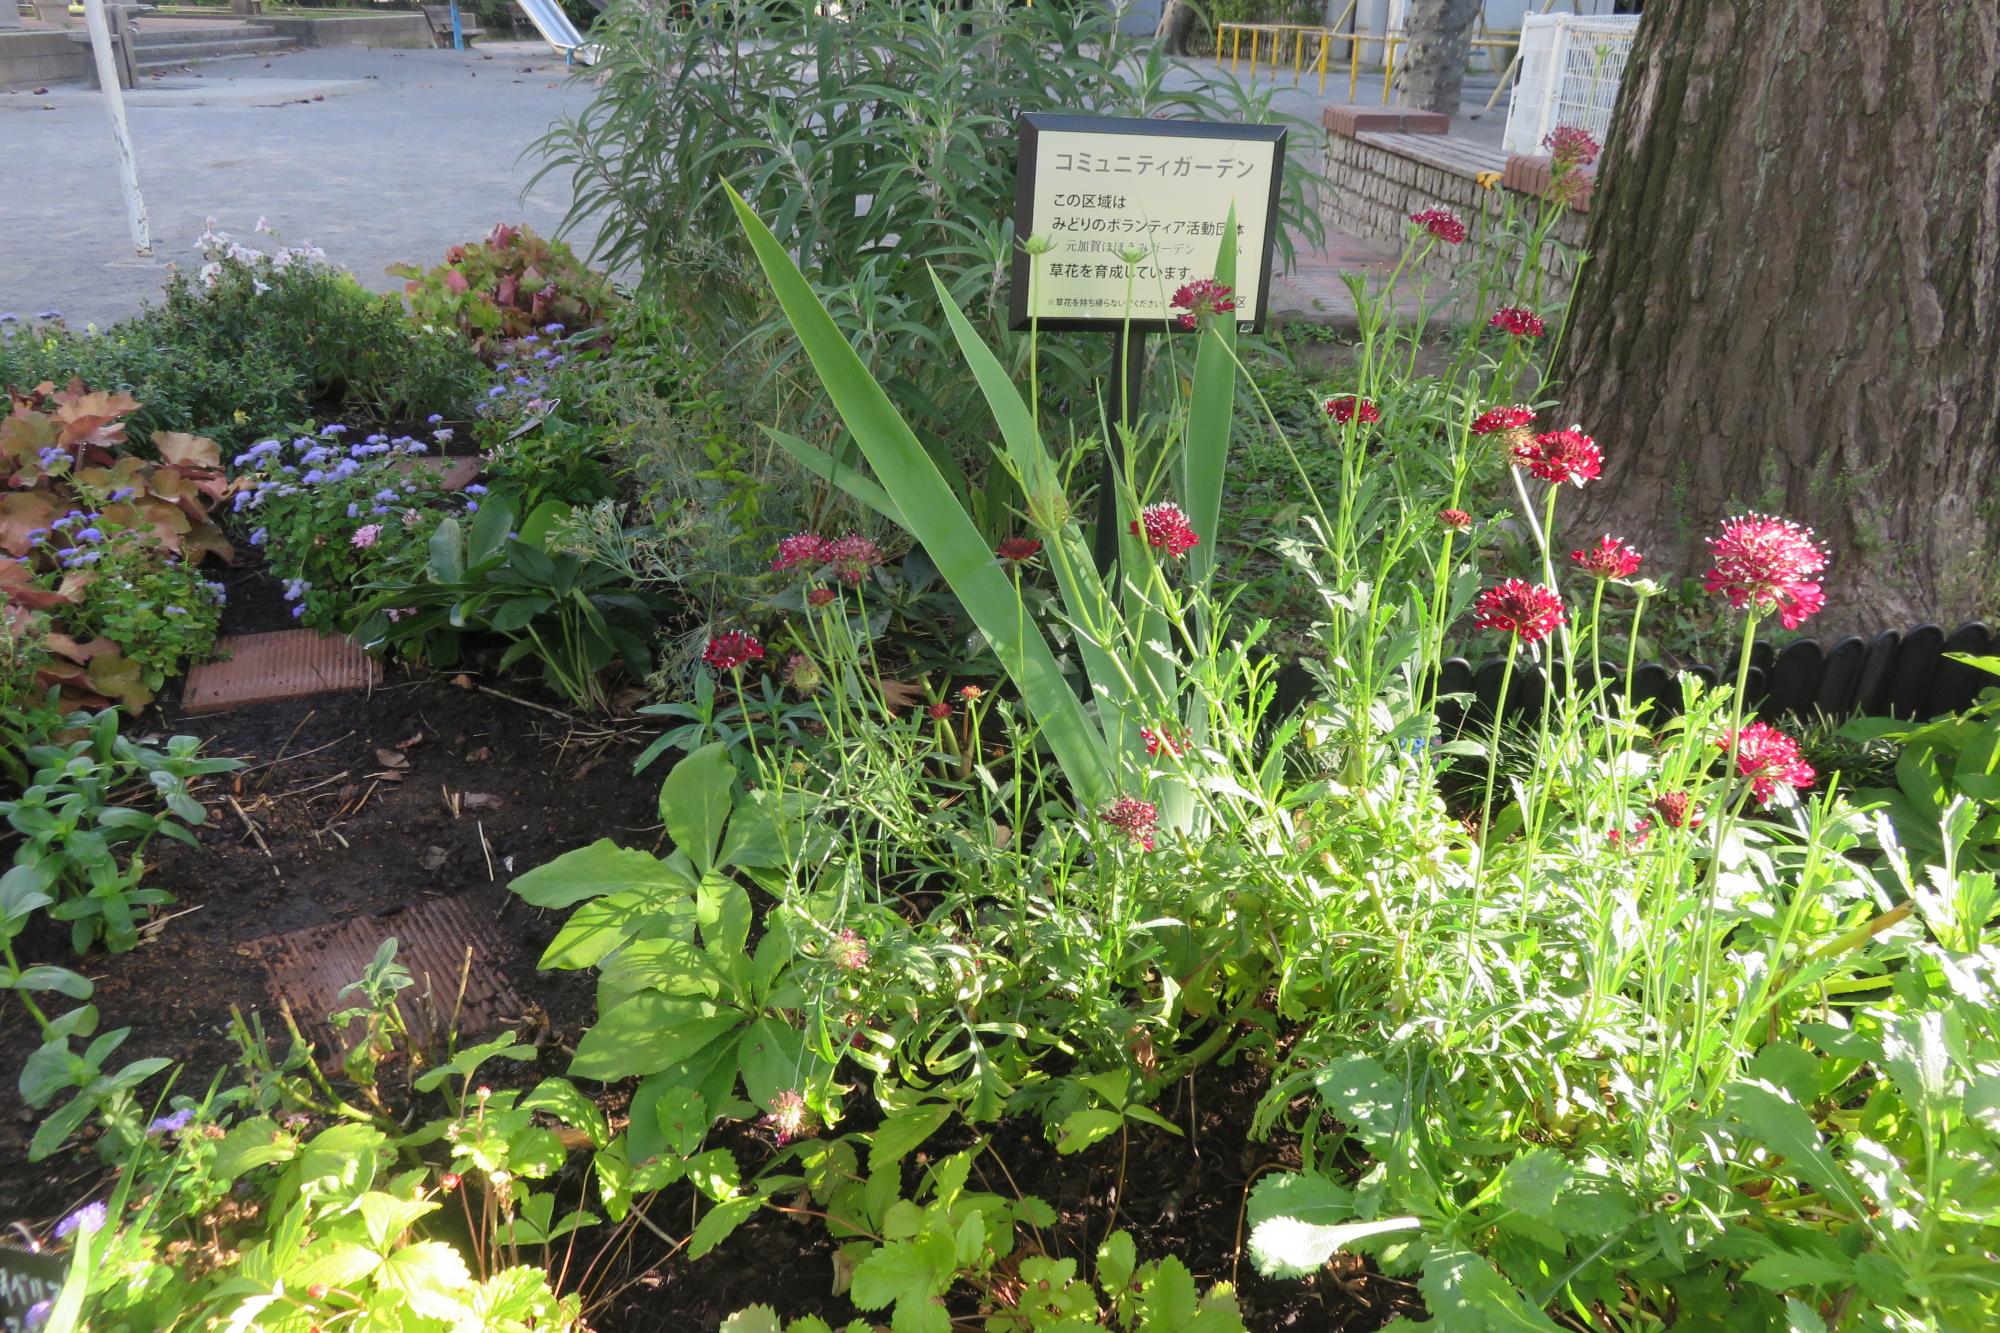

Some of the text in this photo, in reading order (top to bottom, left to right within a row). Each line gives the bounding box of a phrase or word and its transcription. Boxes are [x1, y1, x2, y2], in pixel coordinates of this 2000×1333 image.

[1055, 151, 1255, 179] コミュニティガーデン
[1053, 193, 1127, 210] この区域は
